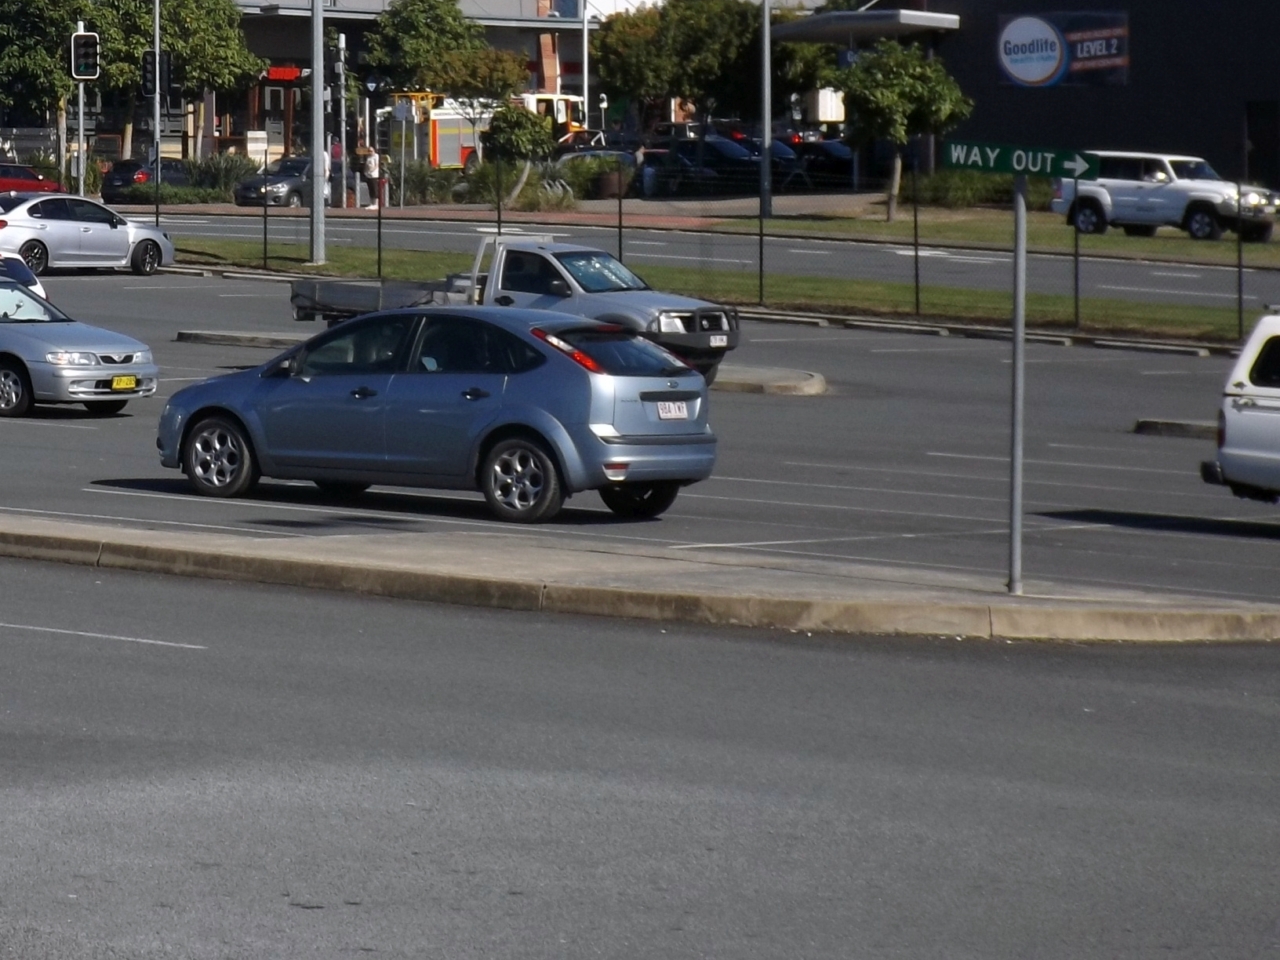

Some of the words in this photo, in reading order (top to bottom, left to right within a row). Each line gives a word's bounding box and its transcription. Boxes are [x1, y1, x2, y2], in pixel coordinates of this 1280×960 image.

[1003, 37, 1058, 56] Goodlife
[1076, 39, 1109, 58] LEVEL
[1110, 38, 1119, 55] 2
[951, 143, 1001, 168] WAY
[1012, 150, 1056, 173] OUT
